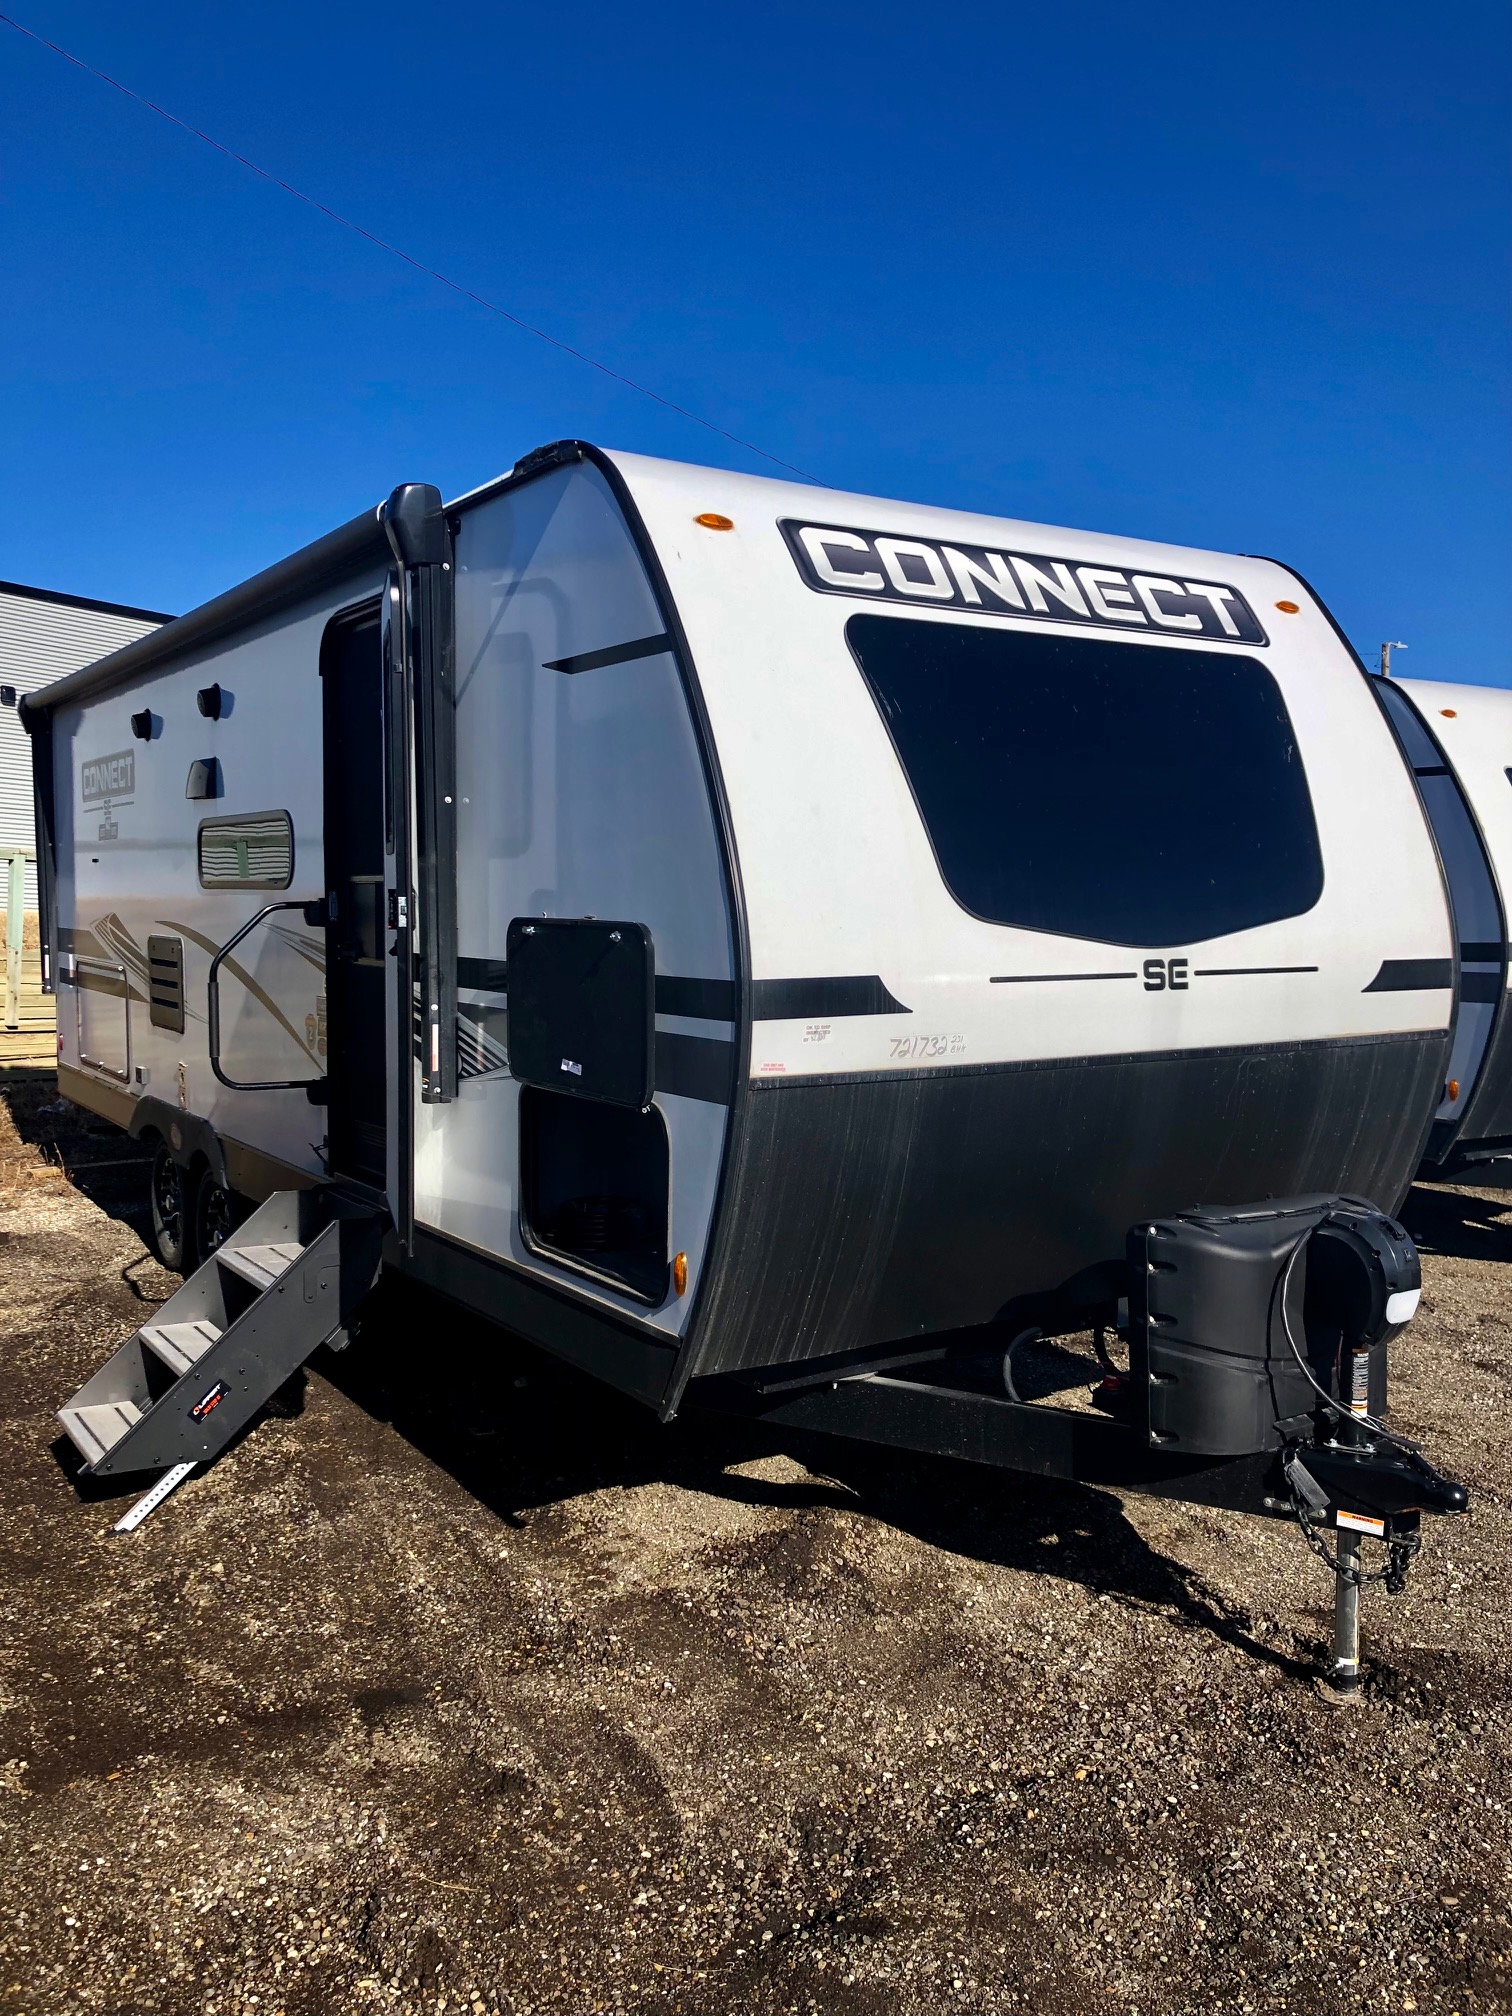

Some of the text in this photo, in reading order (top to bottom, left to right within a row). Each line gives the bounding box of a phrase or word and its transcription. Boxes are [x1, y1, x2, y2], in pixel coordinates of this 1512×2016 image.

[799, 527, 1242, 636] CONNECT
[84, 757, 132, 795] CONNECT
[1143, 958, 1189, 991] SE
[889, 1036, 948, 1058] 721732
[1352, 1515, 1373, 1523] WARNING
